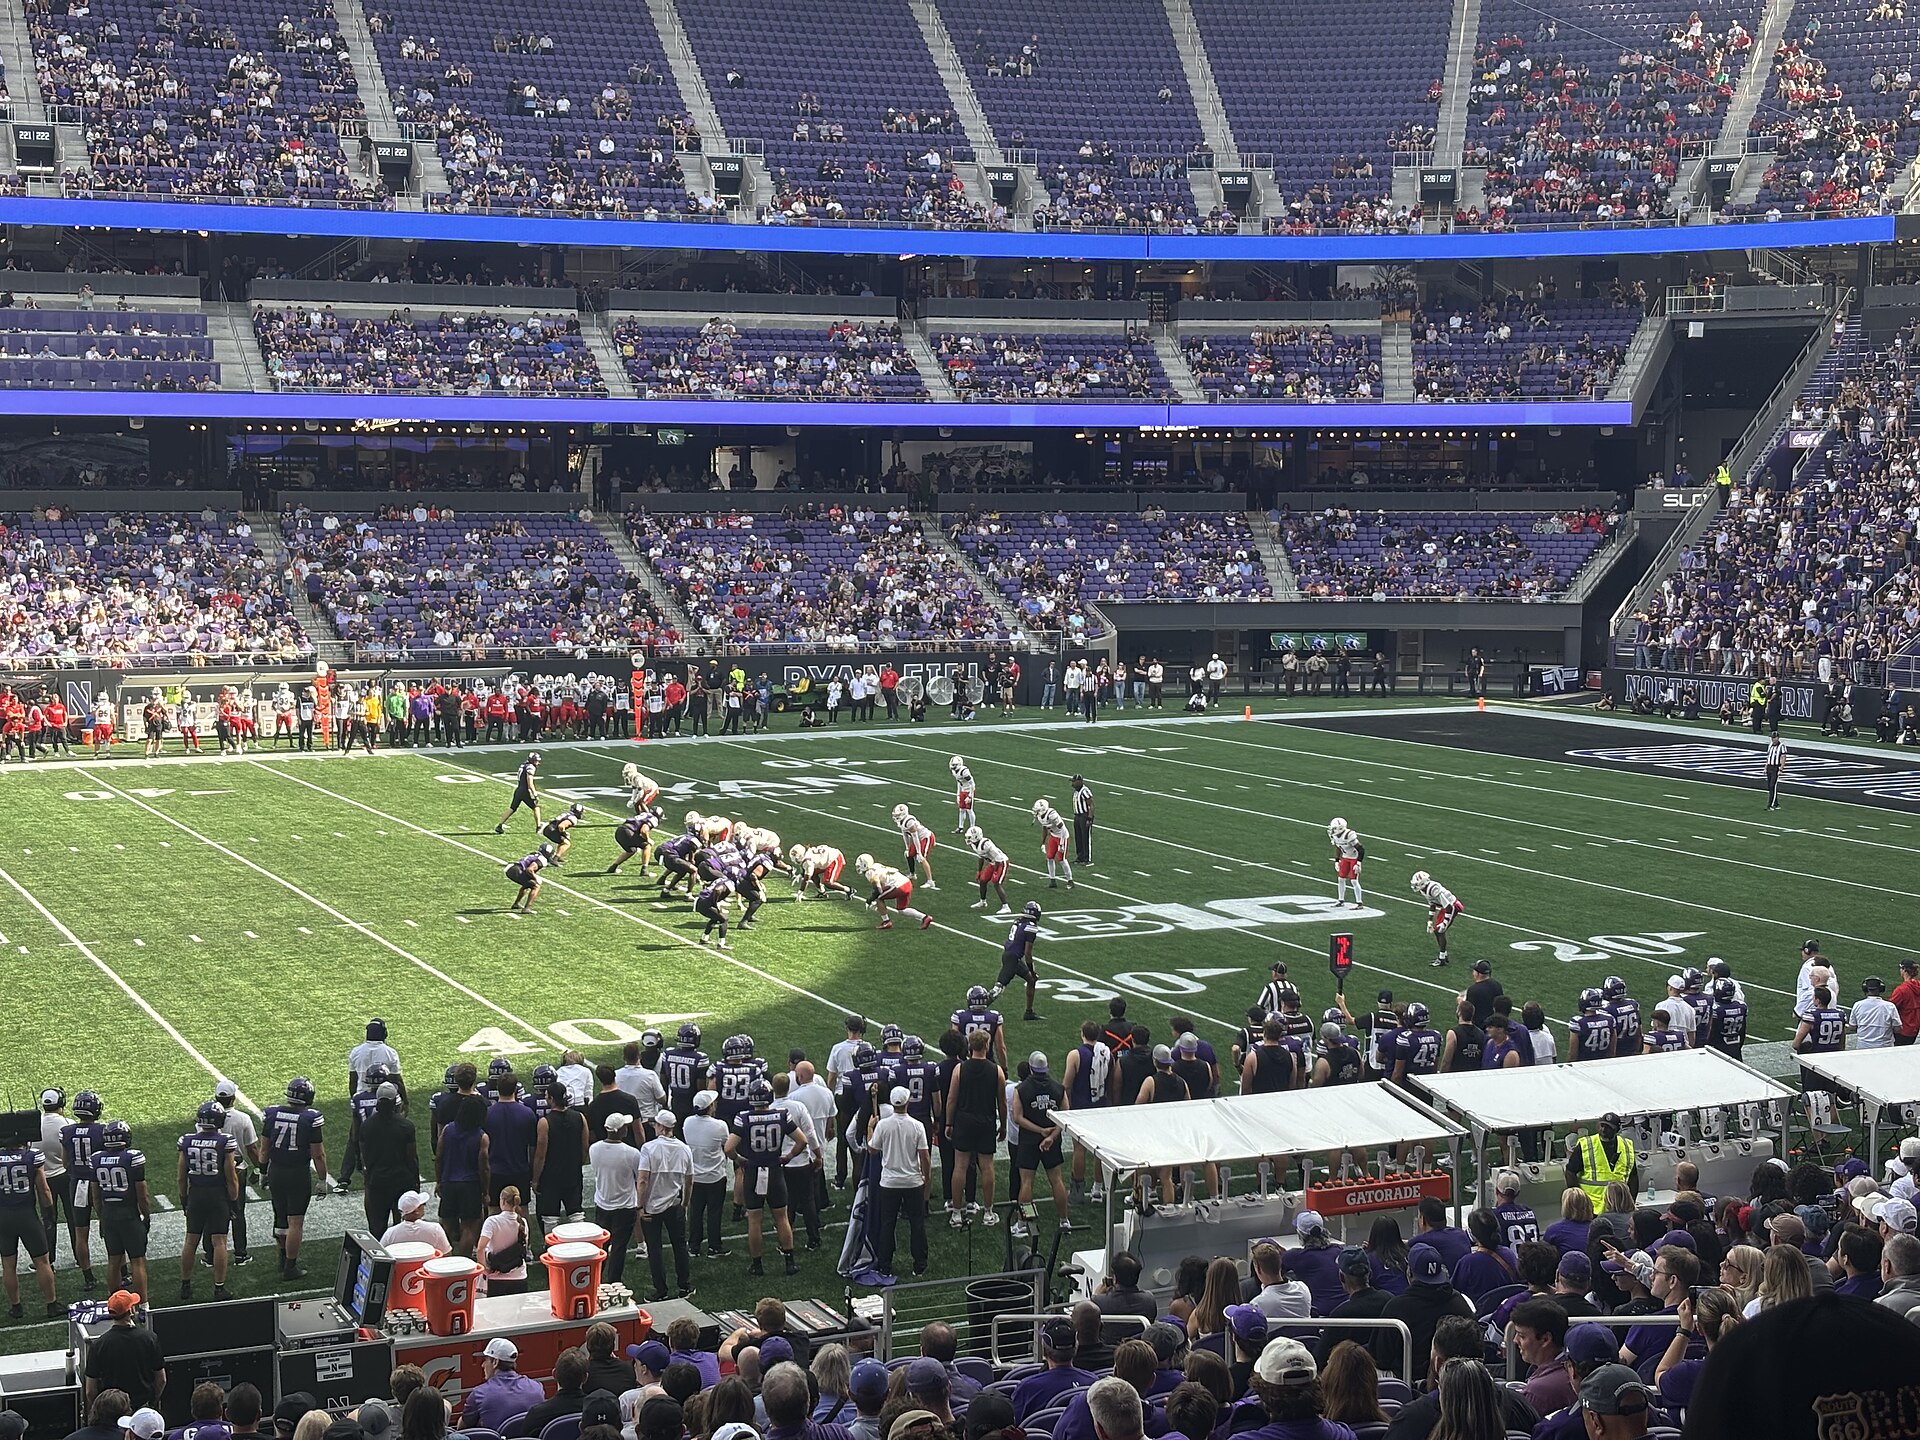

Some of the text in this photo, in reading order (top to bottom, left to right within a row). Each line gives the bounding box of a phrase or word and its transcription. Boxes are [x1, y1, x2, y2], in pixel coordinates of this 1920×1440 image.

[18, 131, 50, 141] 221 222
[377, 147, 408, 157] 222 223
[711, 162, 739, 171] 223 224
[1001, 172, 1014, 181] 225
[1710, 164, 1722, 172] 227
[1221, 176, 1248, 185] 225 226
[1423, 175, 1452, 183] 226 227
[1553, 668, 1565, 691] N
[66, 681, 92, 718] N
[544, 774, 892, 800] RYAN
[664, 787, 835, 802] FIELD
[1336, 936, 1351, 967] 2
[1509, 934, 1687, 962] 20
[1025, 971, 1208, 1003] 30
[456, 1018, 650, 1057] 40
[1584, 1027, 1611, 1052] 48
[1818, 1020, 1843, 1045] 92
[1413, 1043, 1439, 1067] 43
[669, 1062, 691, 1089] 10
[721, 1074, 751, 1101] 83
[908, 1077, 924, 1102] 9
[1035, 1094, 1050, 1103] IRON
[274, 1120, 299, 1151] 71
[750, 1123, 782, 1153] 60
[72, 1137, 92, 1166] 11
[187, 1146, 219, 1176] 38
[0, 1164, 30, 1194] 46
[96, 1166, 129, 1192] 80
[1346, 1185, 1421, 1206] GATORADE
[570, 1265, 591, 1289] G
[1428, 1262, 1437, 1274] N
[446, 1280, 468, 1304] G
[331, 1363, 338, 1372] N
[1820, 1399, 1857, 1412] ROUTE
[1828, 1421, 1861, 1440] 66
